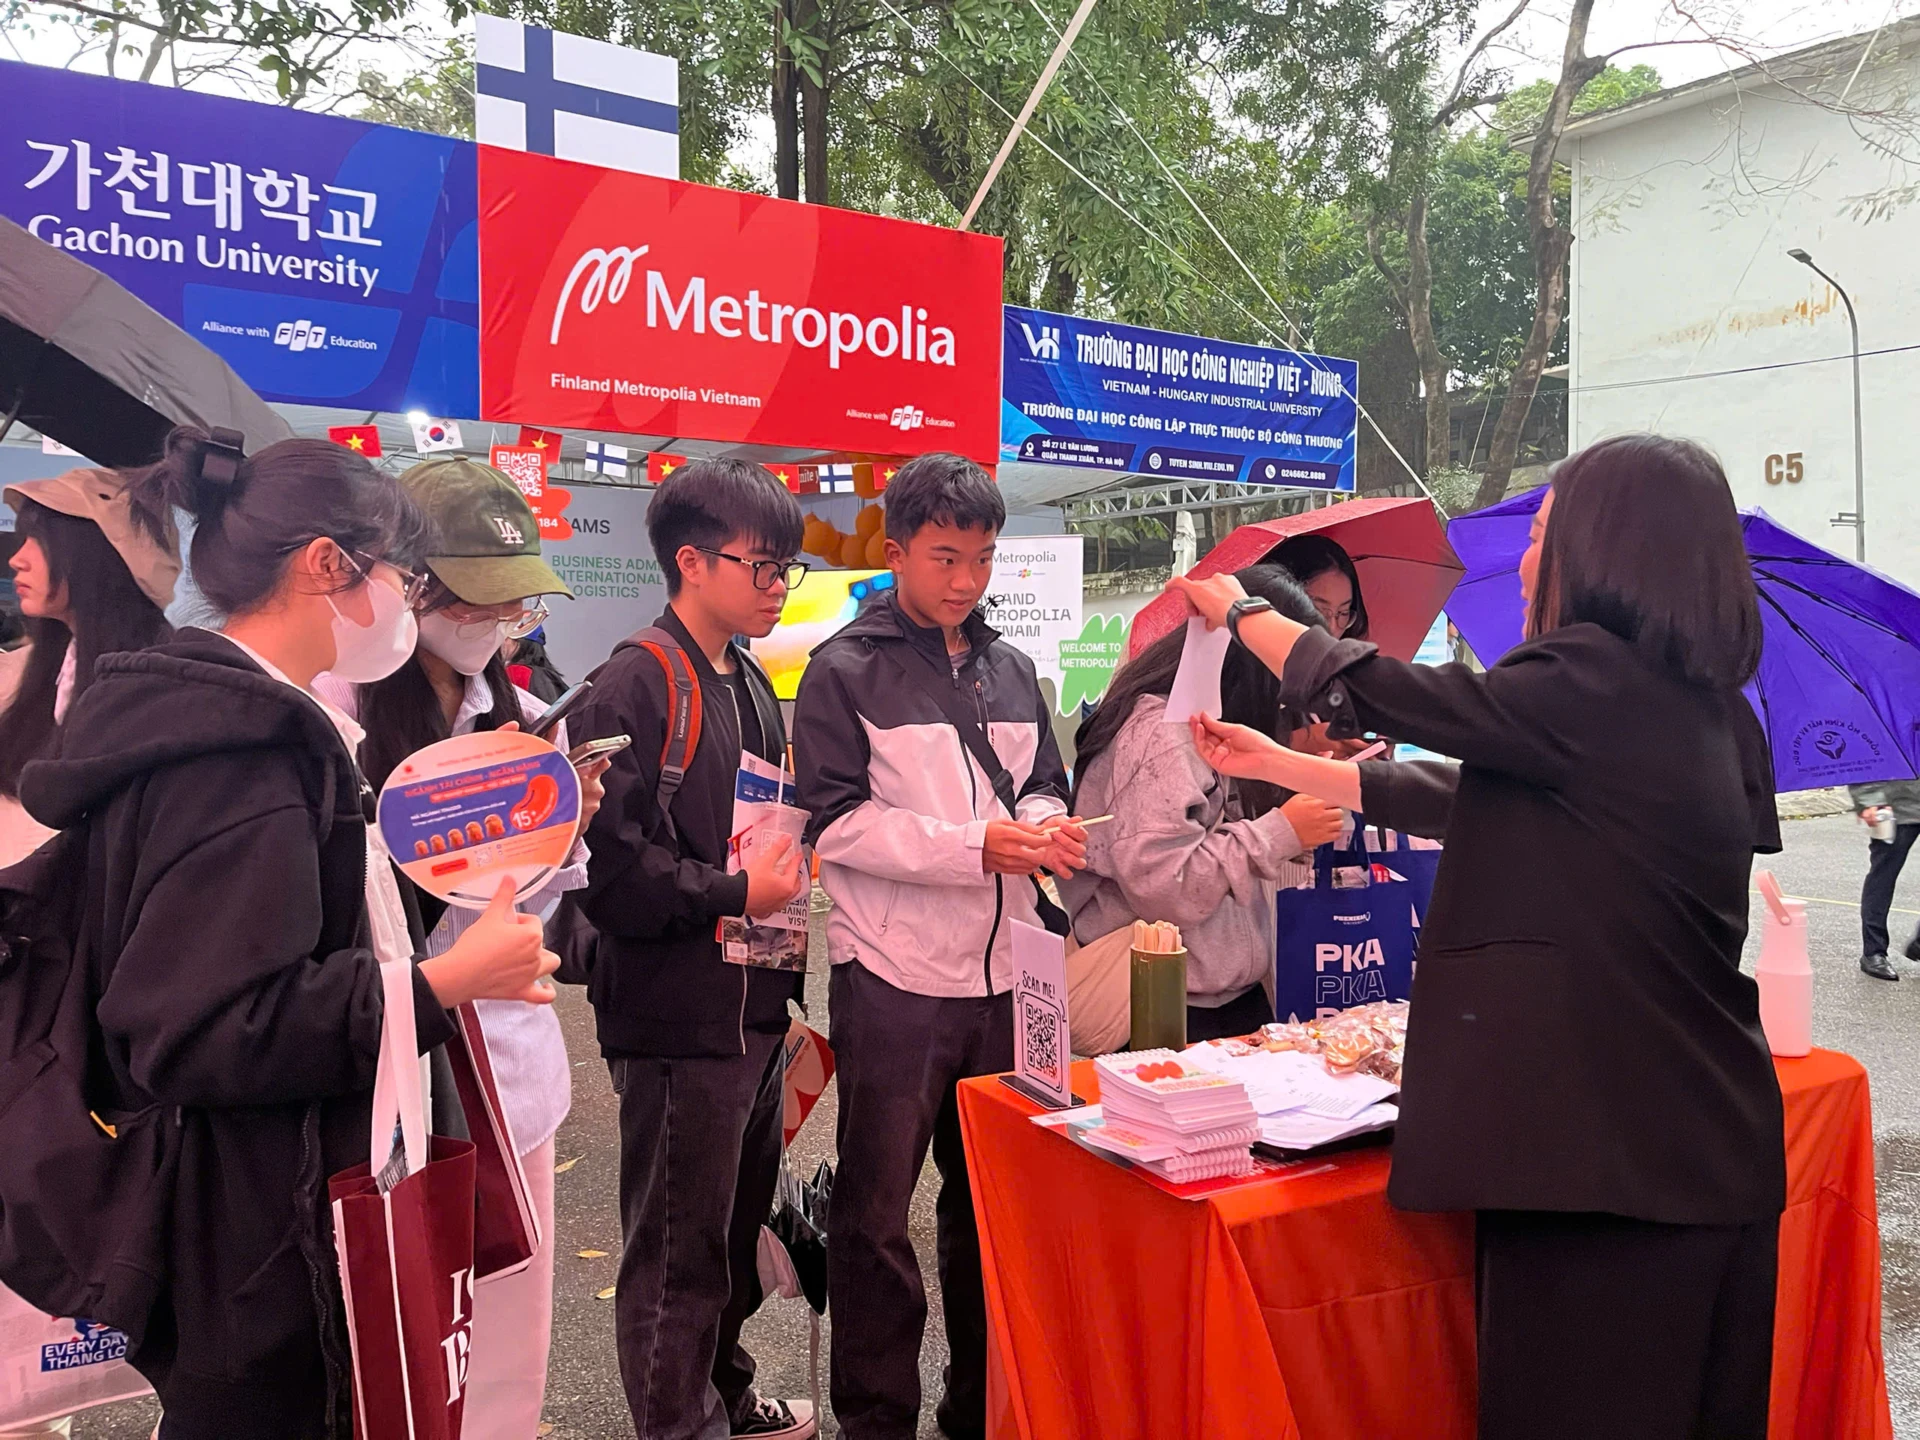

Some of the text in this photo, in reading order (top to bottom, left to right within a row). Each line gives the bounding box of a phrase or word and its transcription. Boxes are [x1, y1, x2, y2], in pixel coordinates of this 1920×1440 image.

[24, 139, 382, 247] 가천대학교
[28, 214, 379, 297] Gachon University
[646, 270, 956, 369] Metropolia
[202, 321, 377, 350] Alliance with FPT Education
[1076, 330, 1132, 369] TRƯỜNG
[1135, 342, 1158, 378] ĐẠI
[1161, 346, 1189, 382] HỌC
[1191, 347, 1227, 384] CÔNG
[1230, 356, 1274, 394] NGHIỆP
[1277, 361, 1302, 397] VIỆT
[551, 373, 761, 407] Finland Metropolia Vietnam
[1102, 378, 1150, 396] VIETNAM
[1158, 387, 1209, 404] HUNGARY
[1210, 394, 1268, 411] INDUSTRIAL
[1270, 401, 1323, 417] UNIVERSITY
[846, 408, 955, 427] Alliance with FPT Education
[1022, 401, 1343, 449] TRƯỜNG ĐẠI HỌC CÔNG LẬP TRỰC THUỘC BỘ CÔNG THƯƠNG
[1051, 441, 1059, 449] 27
[1764, 452, 1804, 485] C5
[493, 518, 525, 544] LA
[570, 517, 611, 535] AMS
[552, 555, 622, 569] BUSINESS
[552, 569, 664, 585] NTERNATIONAL
[572, 584, 640, 598] OGISTICS
[989, 608, 1072, 621] TROPOLIA
[1061, 642, 1121, 653] WELCOME TO
[1061, 657, 1118, 668] METROPOLIA
[788, 916, 807, 927] ASIA
[1316, 938, 1385, 972] PKA
[1042, 982, 1055, 999] ME!
[1316, 970, 1386, 1004] PKA
[45, 1336, 129, 1357] EVERY DAY
[46, 1345, 127, 1369] THANG LO
